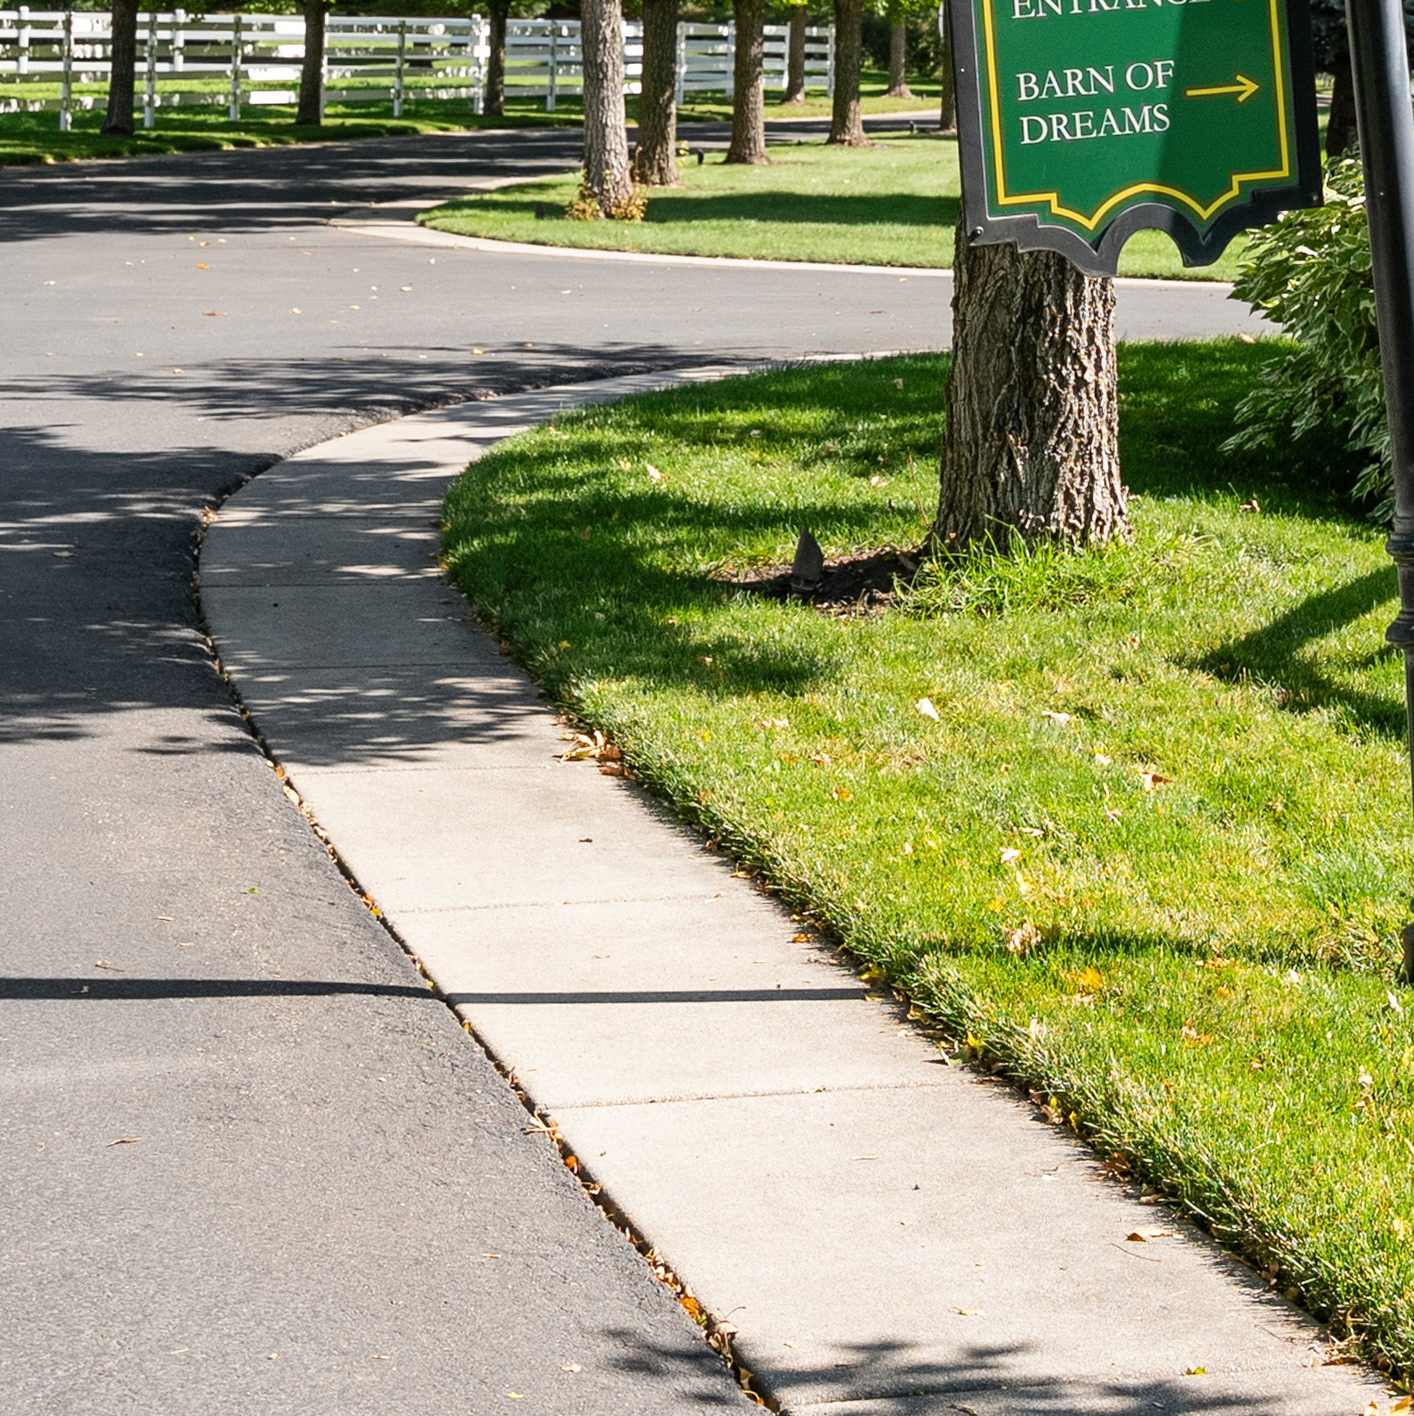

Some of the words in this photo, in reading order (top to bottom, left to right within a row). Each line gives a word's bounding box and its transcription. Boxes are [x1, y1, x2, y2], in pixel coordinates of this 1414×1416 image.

[1016, 65, 1114, 101] BARN
[1126, 60, 1175, 91] OF
[1019, 104, 1171, 145] DREAMS
